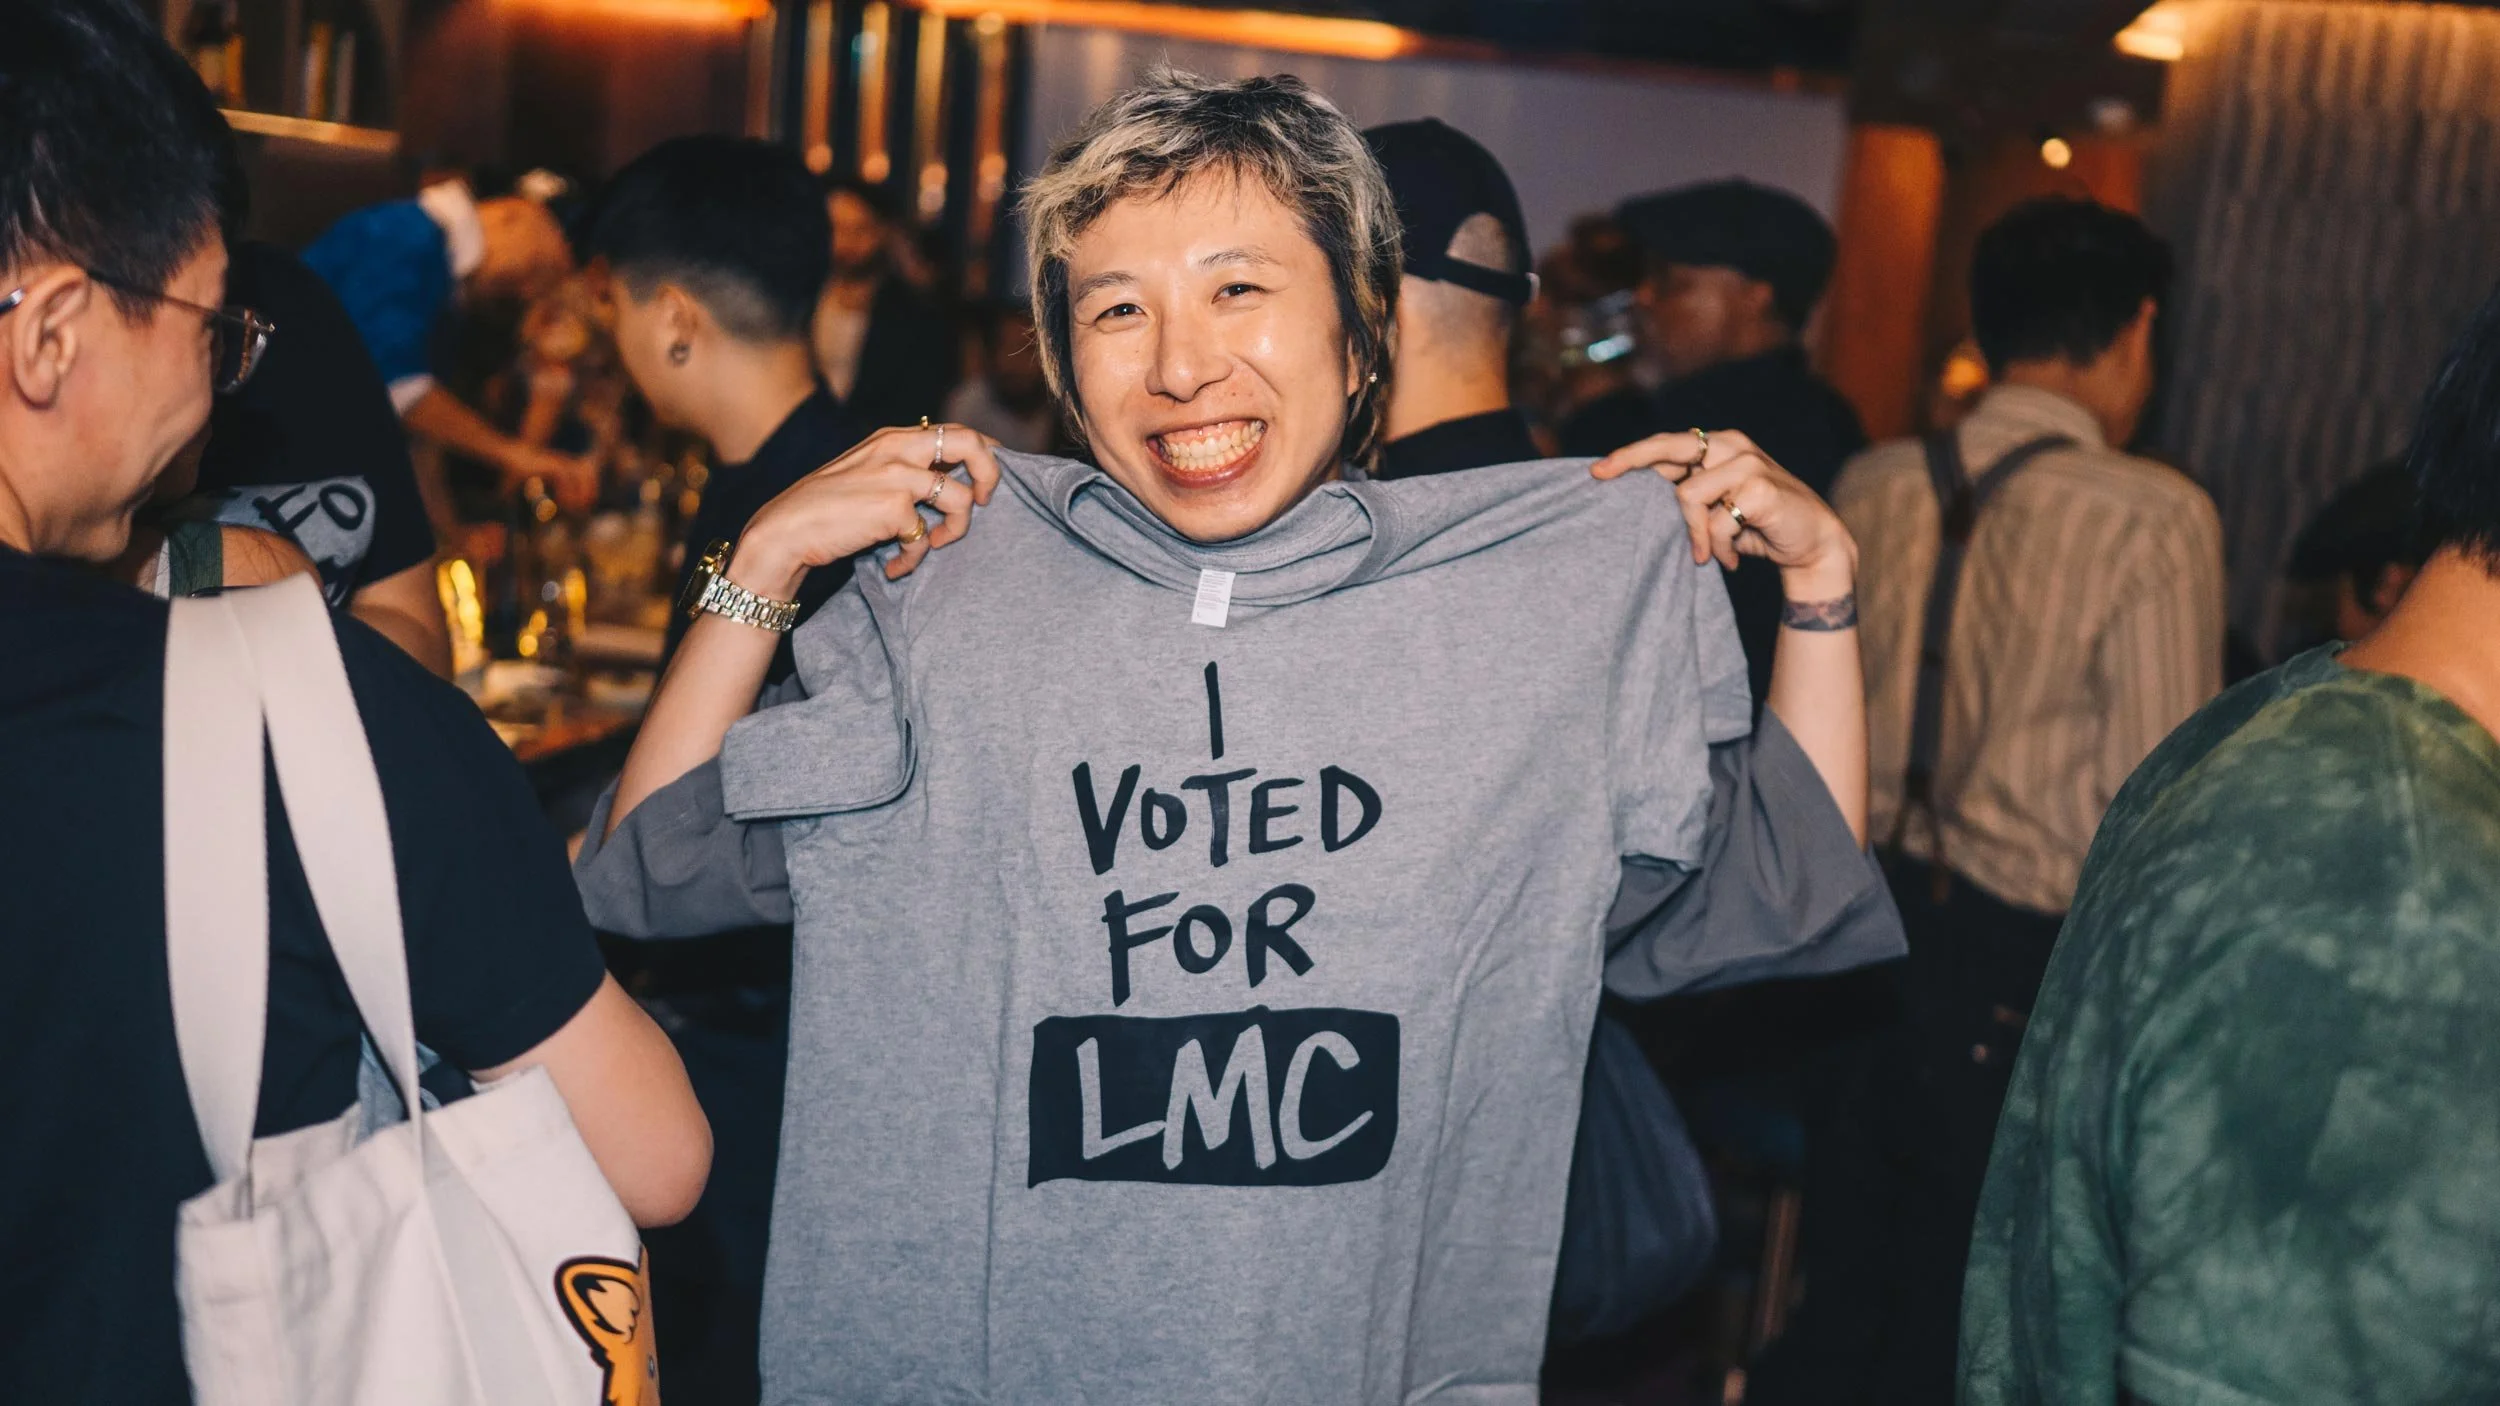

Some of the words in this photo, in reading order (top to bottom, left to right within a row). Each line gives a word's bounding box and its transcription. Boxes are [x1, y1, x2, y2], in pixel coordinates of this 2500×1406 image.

[1204, 661, 1224, 760] I
[1102, 883, 1316, 1007] FOR
[1076, 1024, 1374, 1170] LMC
